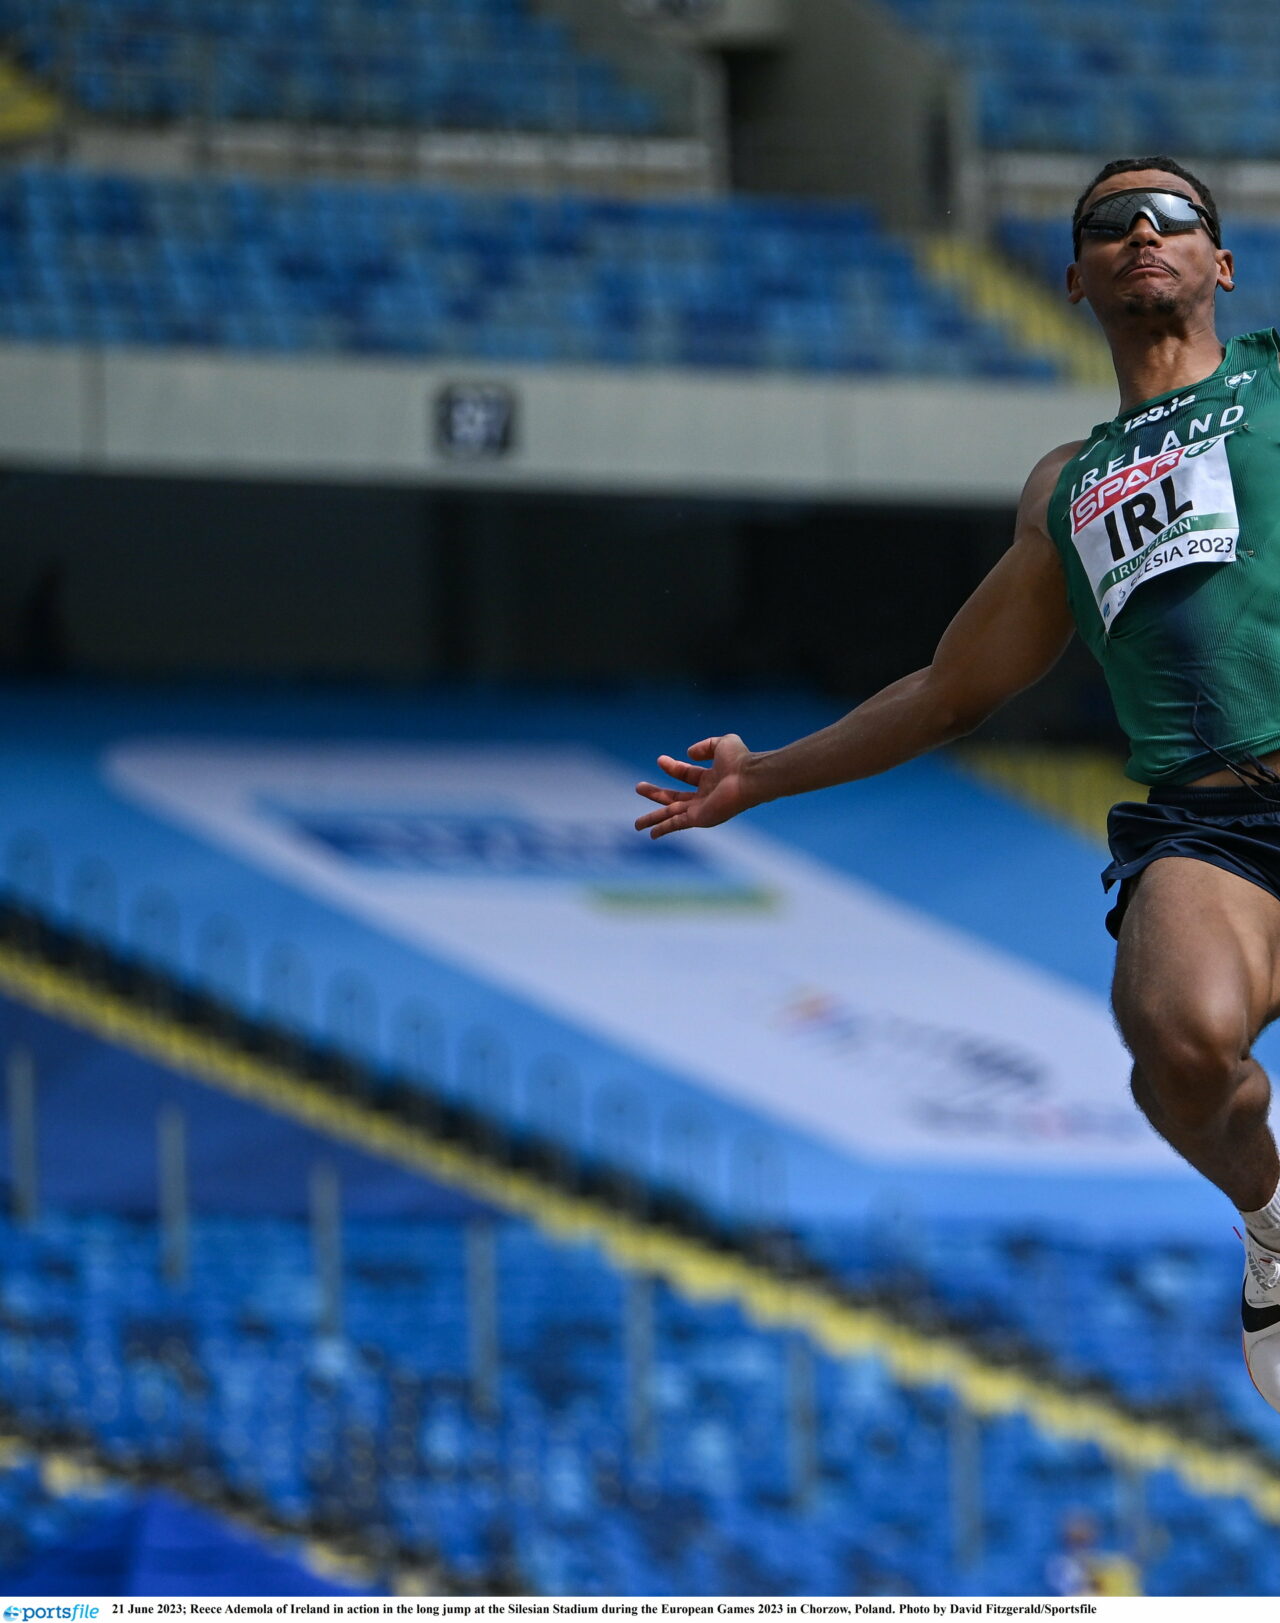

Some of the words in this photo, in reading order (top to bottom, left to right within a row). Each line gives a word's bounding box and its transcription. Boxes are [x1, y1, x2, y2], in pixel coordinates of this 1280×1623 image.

[1070, 405, 1244, 502] IRELAND
[1075, 451, 1180, 528] SPAR
[1103, 475, 1194, 562] IRL
[1186, 536, 1234, 556] 2023
